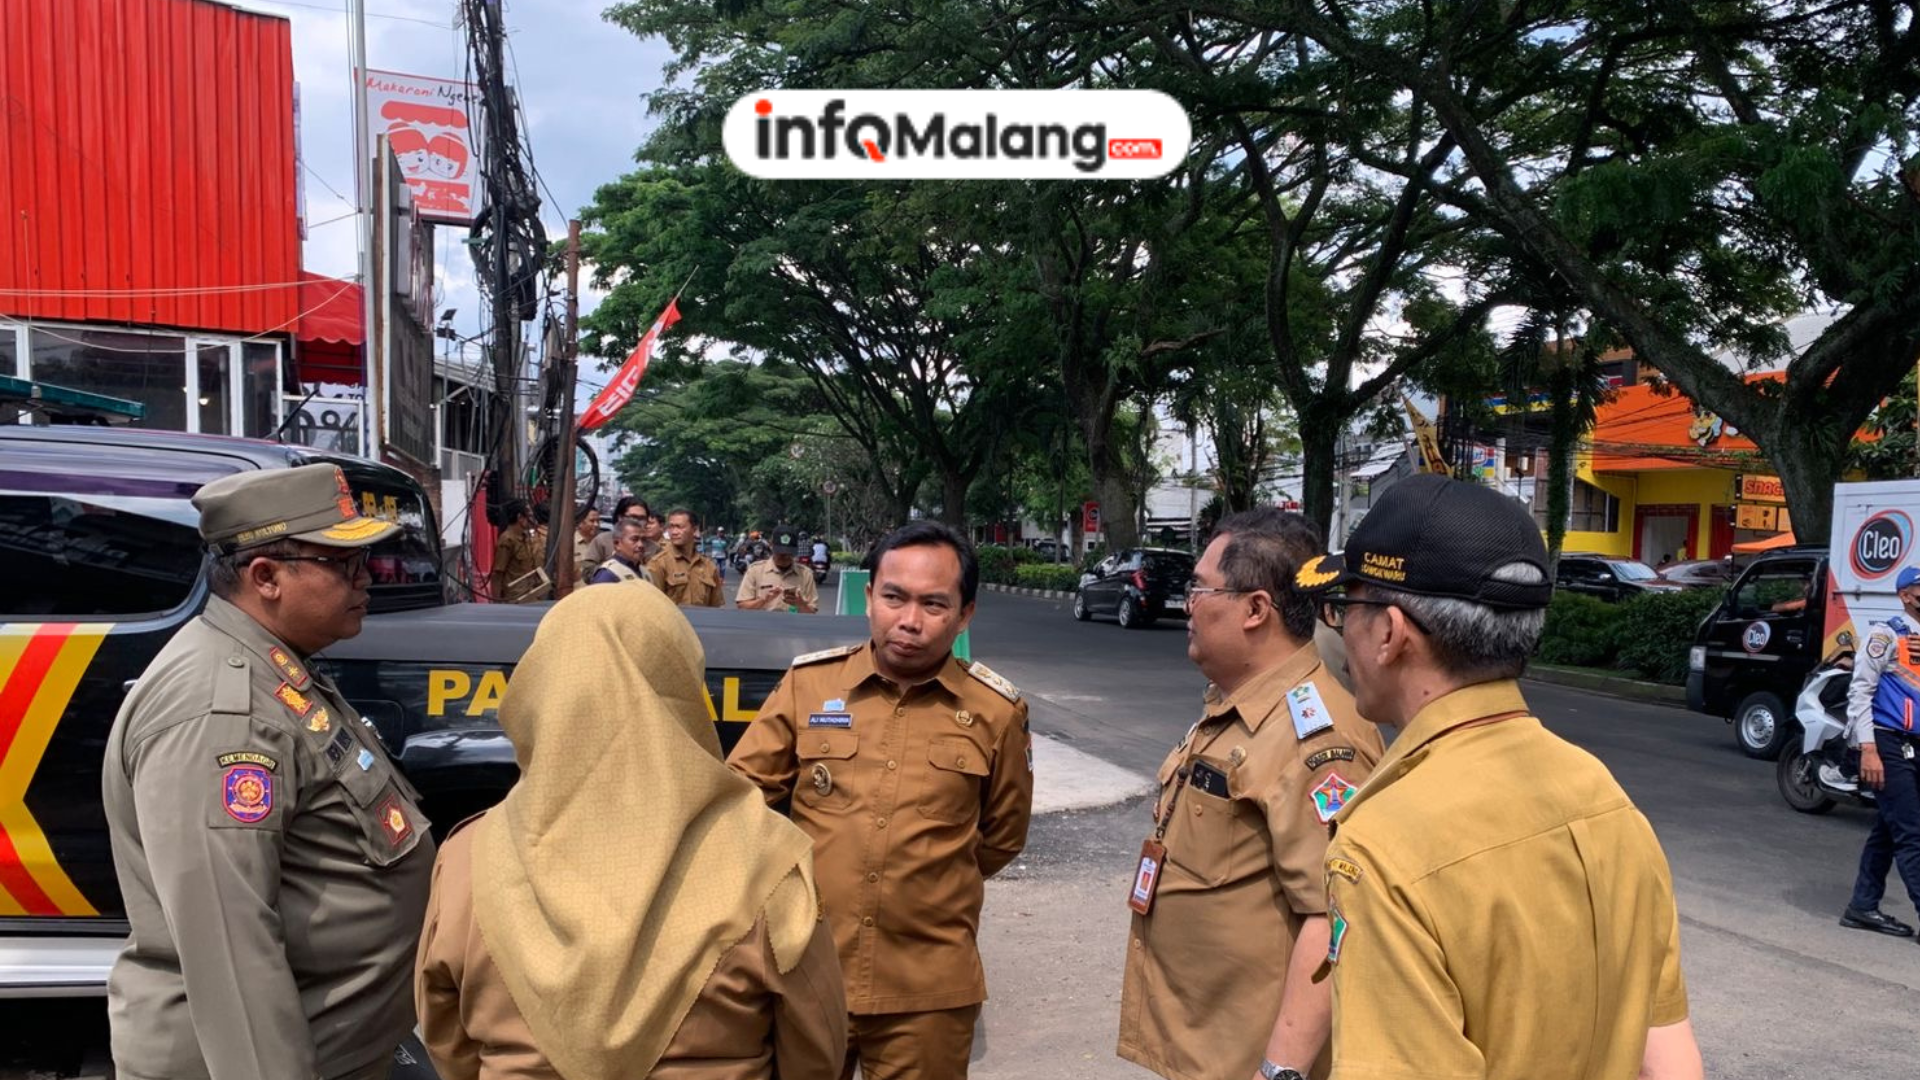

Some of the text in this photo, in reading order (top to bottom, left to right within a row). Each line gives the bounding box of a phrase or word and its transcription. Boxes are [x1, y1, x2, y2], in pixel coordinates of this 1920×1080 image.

[1863, 530, 1900, 559] Cleo
[1364, 551, 1405, 570] CAMAT
[1747, 629, 1766, 648] Cleo
